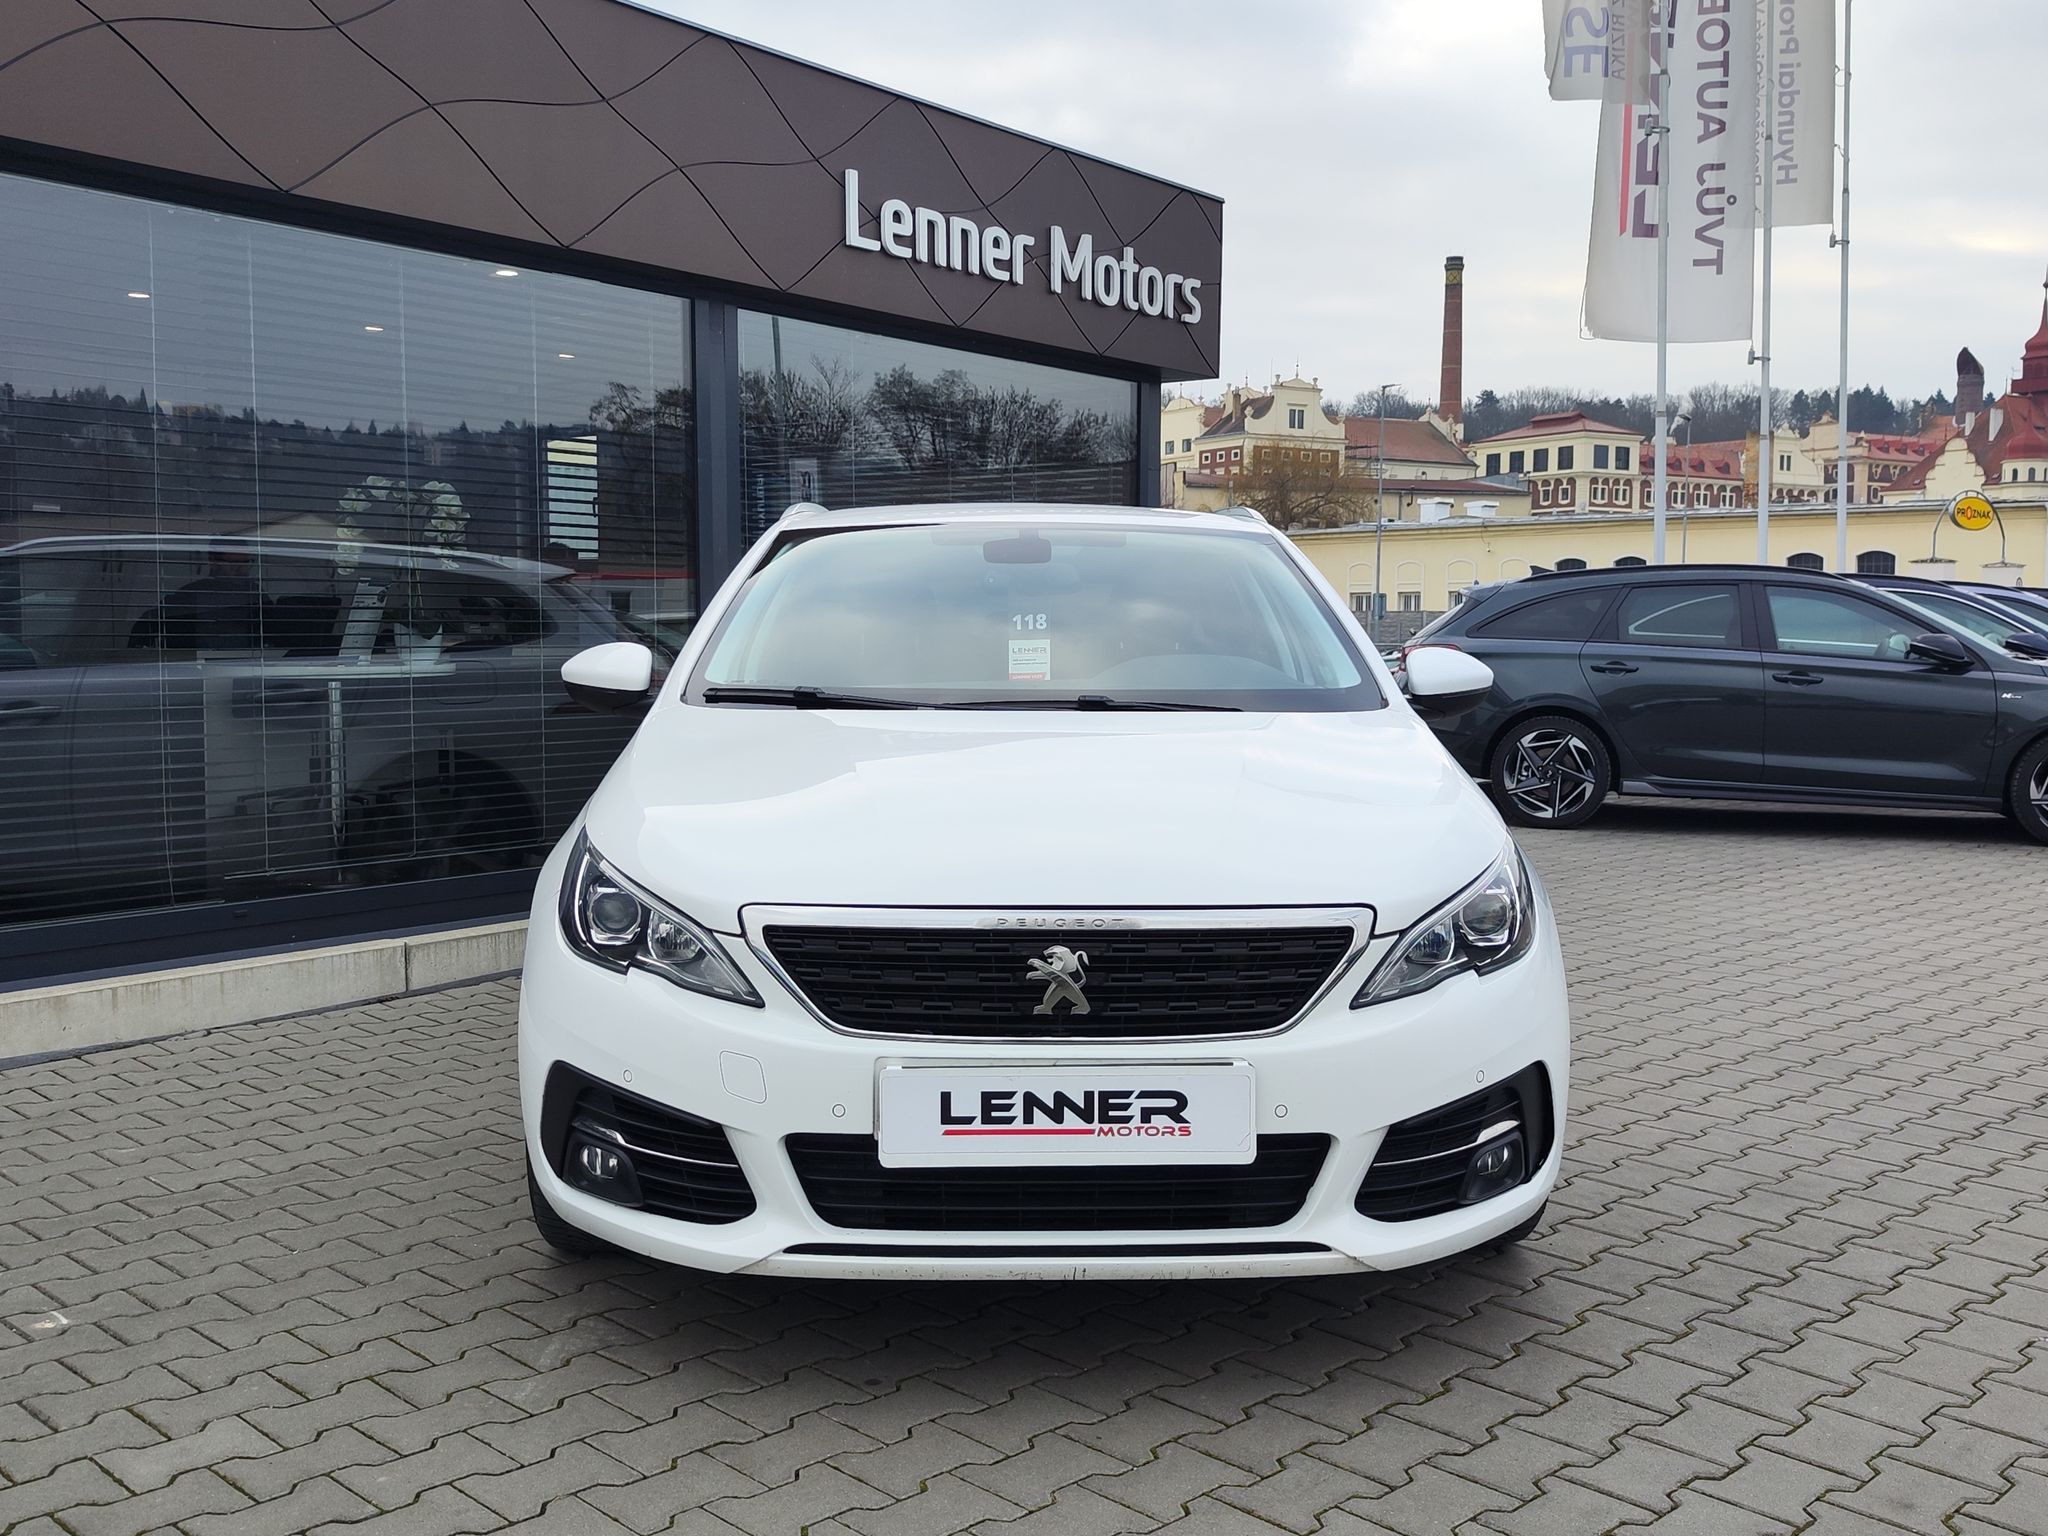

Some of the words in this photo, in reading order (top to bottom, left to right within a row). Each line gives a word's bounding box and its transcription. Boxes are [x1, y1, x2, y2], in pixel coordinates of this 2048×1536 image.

[844, 168, 1035, 286] Lenner
[1049, 225, 1202, 325] Motors
[1012, 613, 1047, 631] 118
[996, 917, 1125, 928] PEUGEOT
[939, 1089, 1192, 1126] LENNER
[1096, 1125, 1192, 1137] MOTORS
